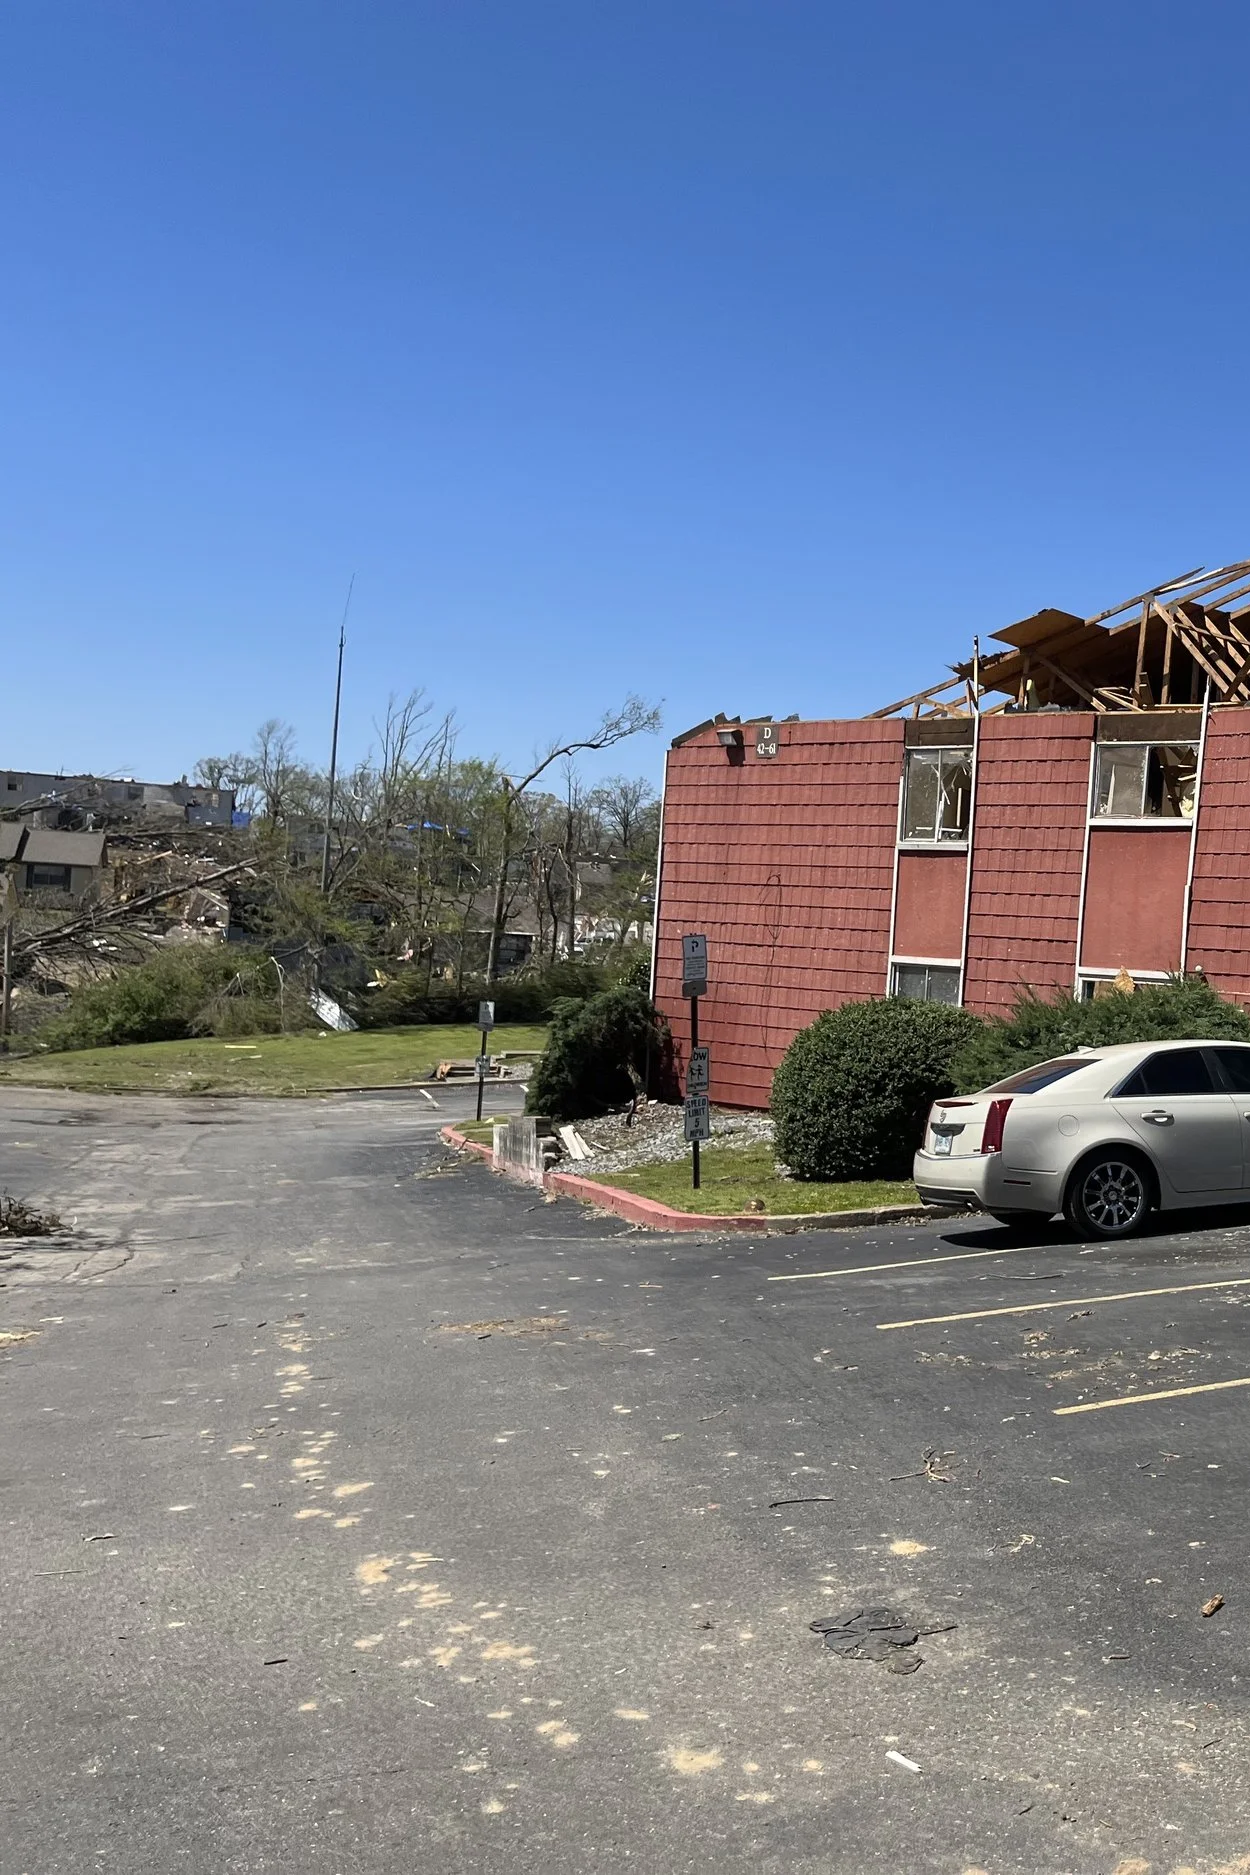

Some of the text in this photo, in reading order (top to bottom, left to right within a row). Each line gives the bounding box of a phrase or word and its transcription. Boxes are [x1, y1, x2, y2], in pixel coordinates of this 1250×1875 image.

[763, 727, 772, 739] D
[693, 1051, 707, 1061] OW
[686, 1098, 707, 1109] SPEED
[688, 1107, 706, 1117] LIMIT
[694, 1117, 700, 1128] 5
[689, 1129, 704, 1138] MPH
